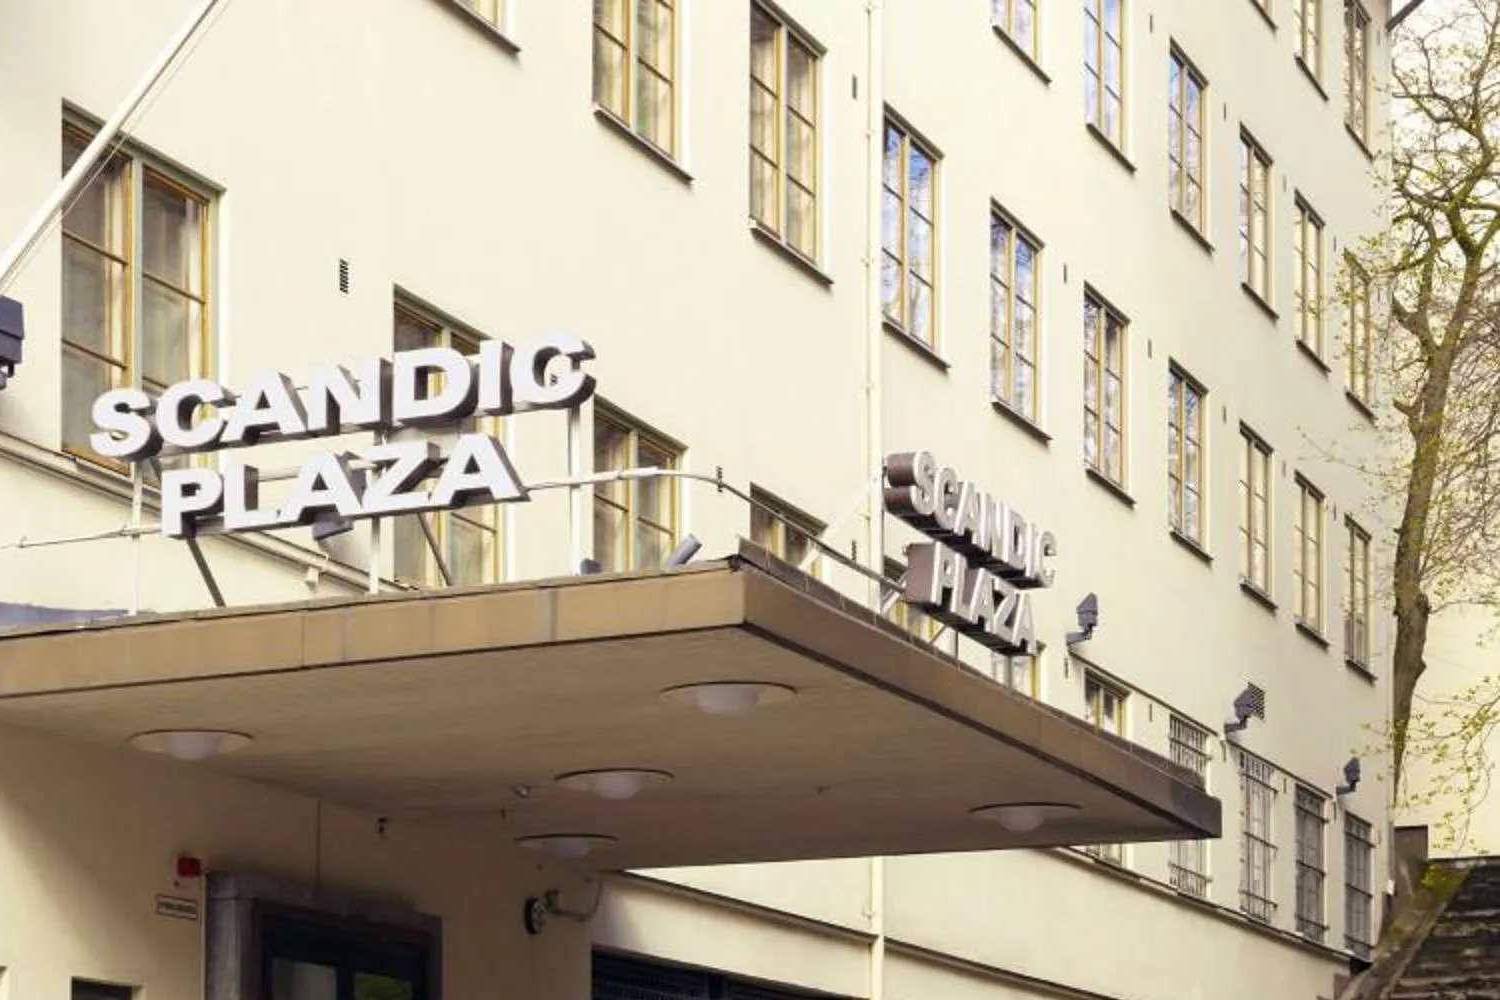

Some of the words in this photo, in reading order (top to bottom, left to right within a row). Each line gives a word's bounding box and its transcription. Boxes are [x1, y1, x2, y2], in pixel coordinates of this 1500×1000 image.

[89, 331, 596, 459] SCANDIC
[161, 432, 530, 537] PLAZA
[908, 450, 1058, 588] SCANDIC
[928, 541, 1037, 656] PLAZA
